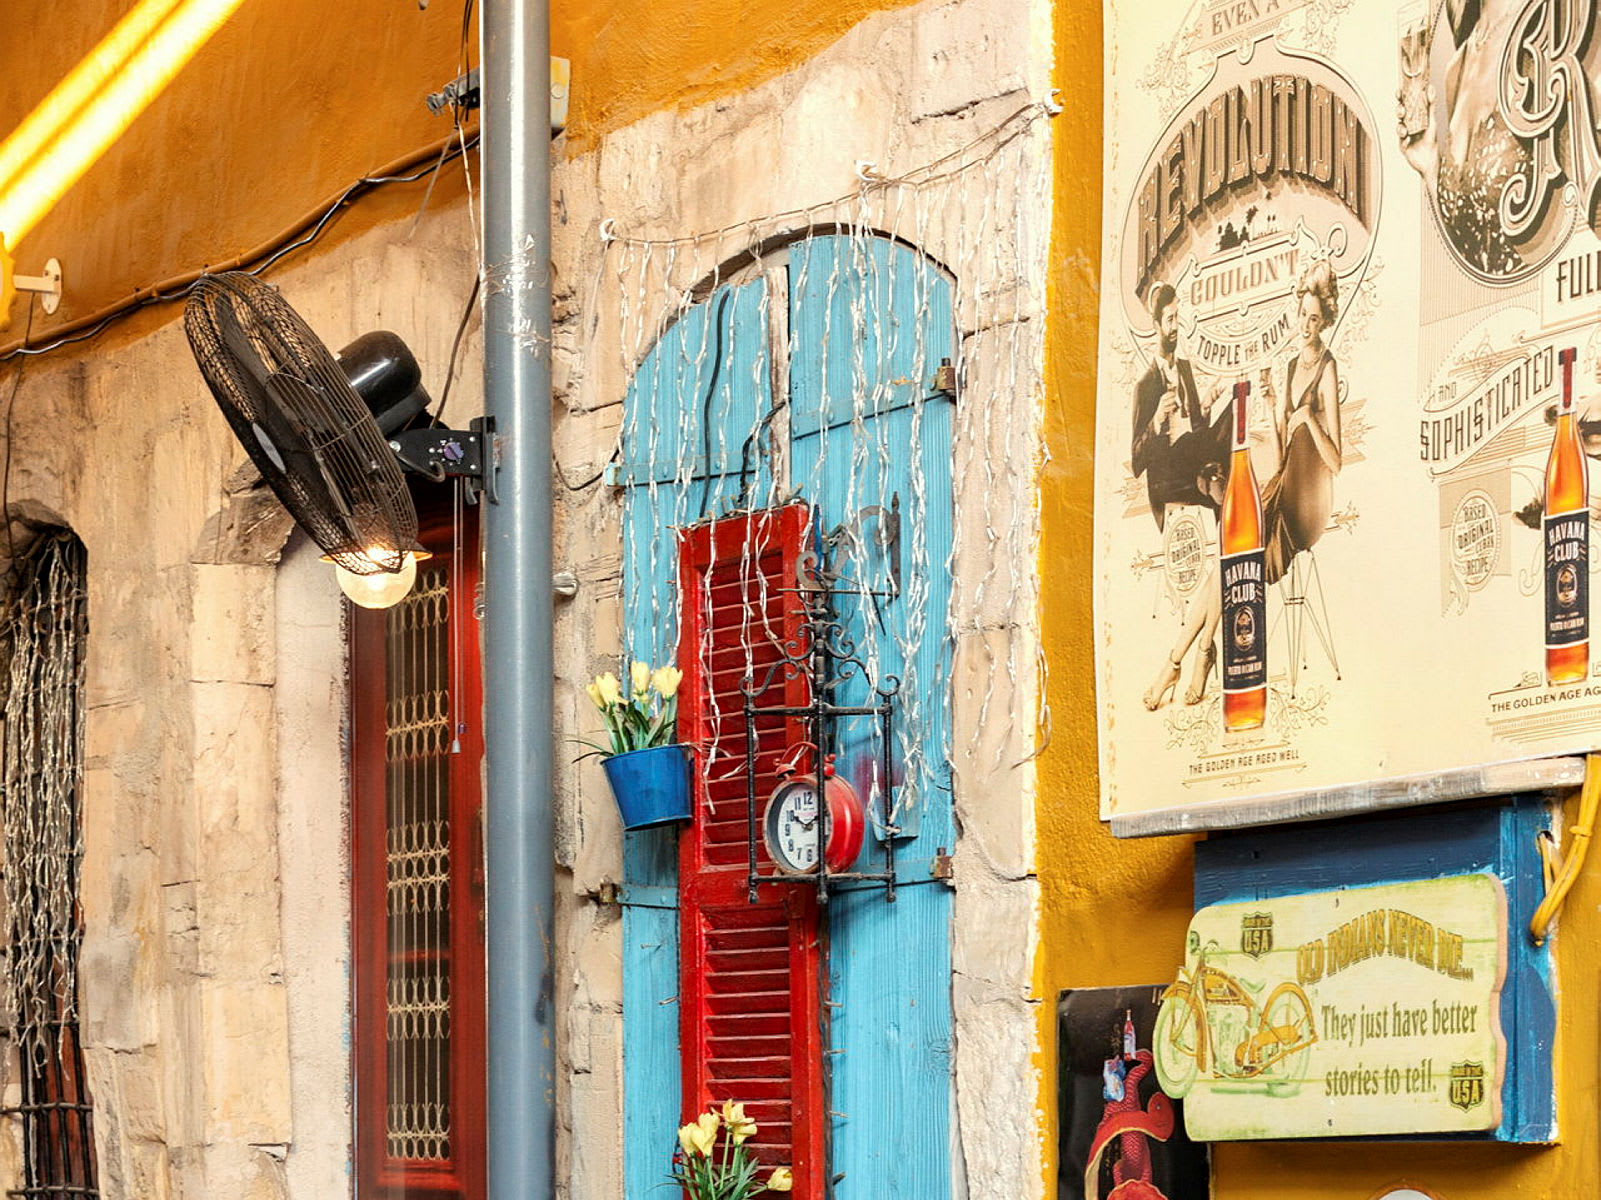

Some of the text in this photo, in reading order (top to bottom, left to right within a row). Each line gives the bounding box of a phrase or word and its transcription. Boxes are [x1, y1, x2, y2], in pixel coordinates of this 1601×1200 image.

[1136, 73, 1370, 287] REVOLUTION
[1190, 248, 1300, 306] COULDN'T
[1197, 313, 1291, 366] TOPPLE THE RUM
[1420, 345, 1554, 461] SOPHISTICATED
[1547, 520, 1586, 546] HAVANA
[1554, 541, 1579, 562] CLUB
[1224, 560, 1262, 587] HAVANA
[1231, 582, 1257, 604] CLUB
[1491, 702, 1512, 712] THE
[1513, 694, 1556, 709] GOLDEN
[1559, 689, 1582, 701] AGE
[1189, 749, 1299, 775] THE GOLDEN AGE AGED WELL
[794, 796, 802, 810] 11
[803, 791, 813, 805] 12
[785, 824, 791, 837] 9
[788, 839, 794, 852] 8
[797, 847, 803, 861] 7
[806, 849, 813, 862] 6
[1244, 930, 1271, 953] USA
[1296, 938, 1326, 986] OLD
[1326, 908, 1386, 978] INDIANS
[1387, 908, 1435, 972] NEVER
[1321, 998, 1478, 1047] They just have better
[1325, 1062, 1379, 1097] stories
[1384, 1064, 1400, 1095] to
[1452, 1079, 1481, 1104] USA
